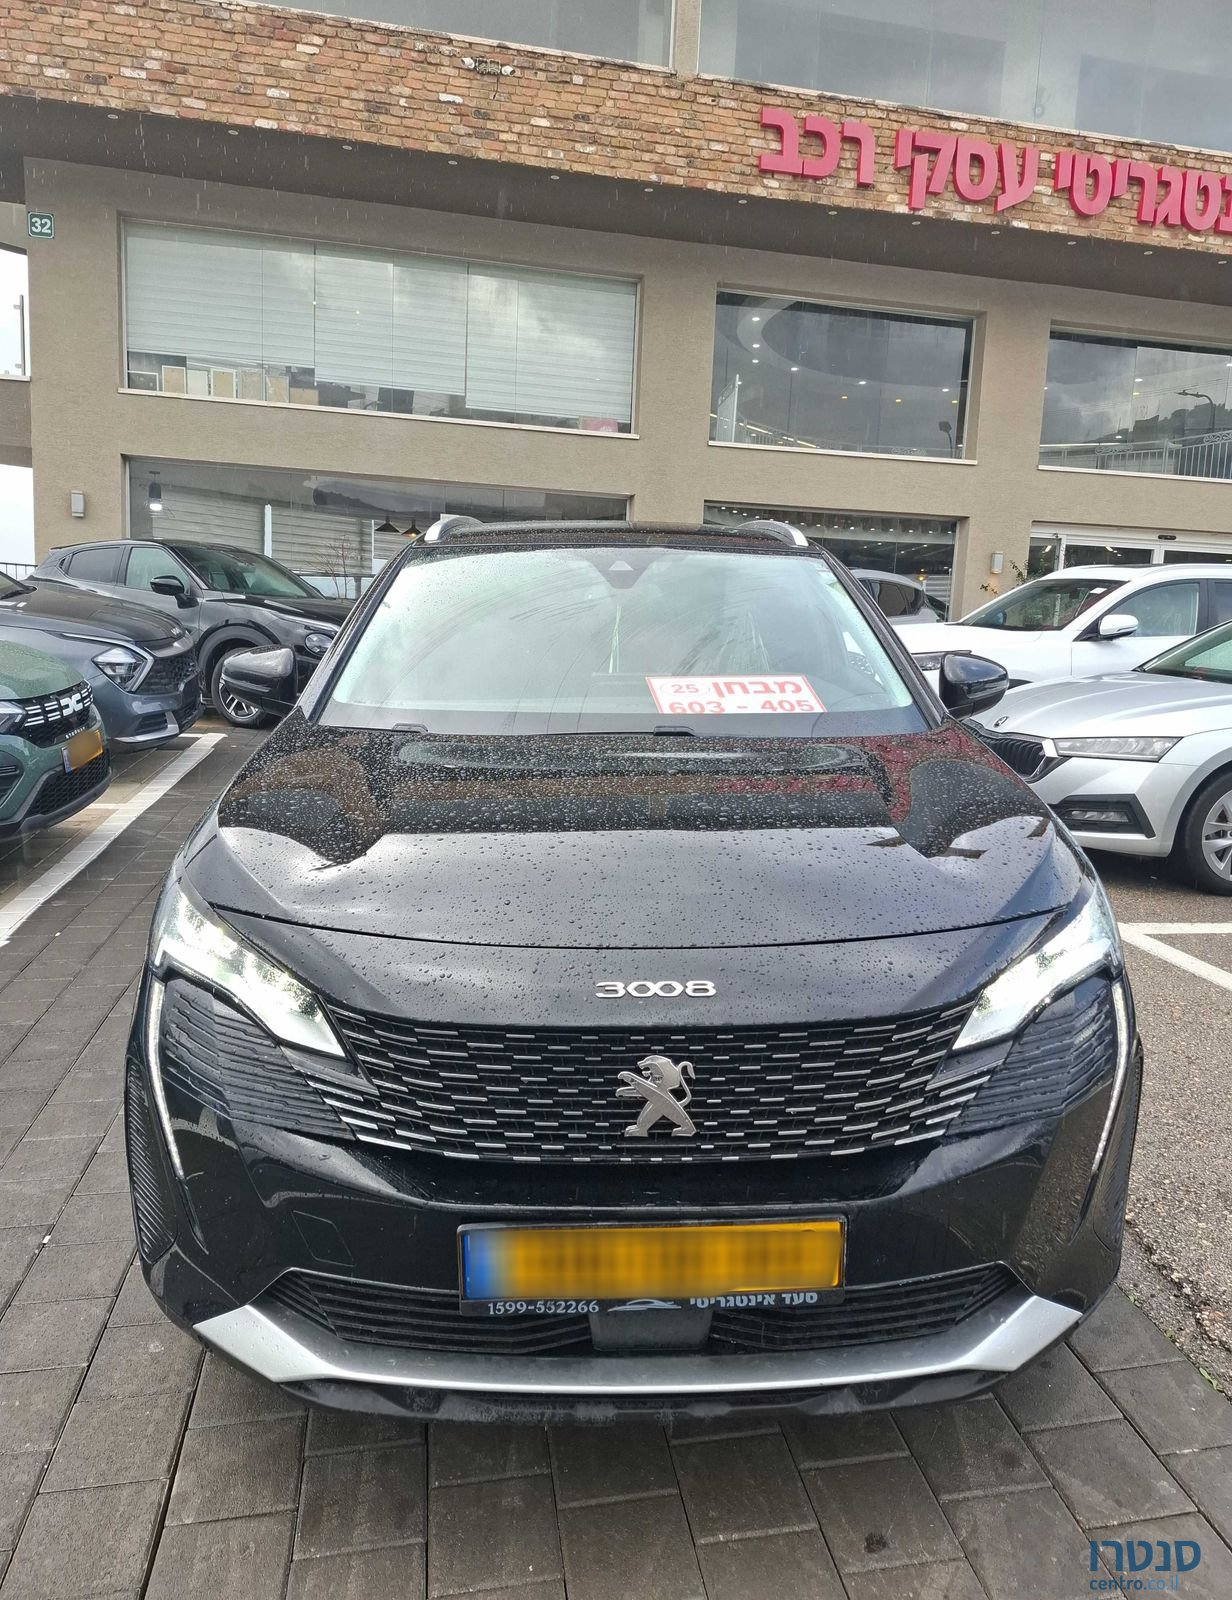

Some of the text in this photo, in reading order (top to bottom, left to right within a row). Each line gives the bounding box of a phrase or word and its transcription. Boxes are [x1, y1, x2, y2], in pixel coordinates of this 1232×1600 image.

[758, 107, 876, 188] רכב
[895, 127, 1039, 212] עסקי
[31, 217, 52, 234] 32
[671, 681, 803, 698] מבחן 25
[668, 700, 726, 715] 603
[760, 699, 815, 713] 405
[595, 980, 717, 998] 3008
[487, 1300, 600, 1315] 1599-552266
[689, 1292, 818, 1309] סעד אינטגריטי
